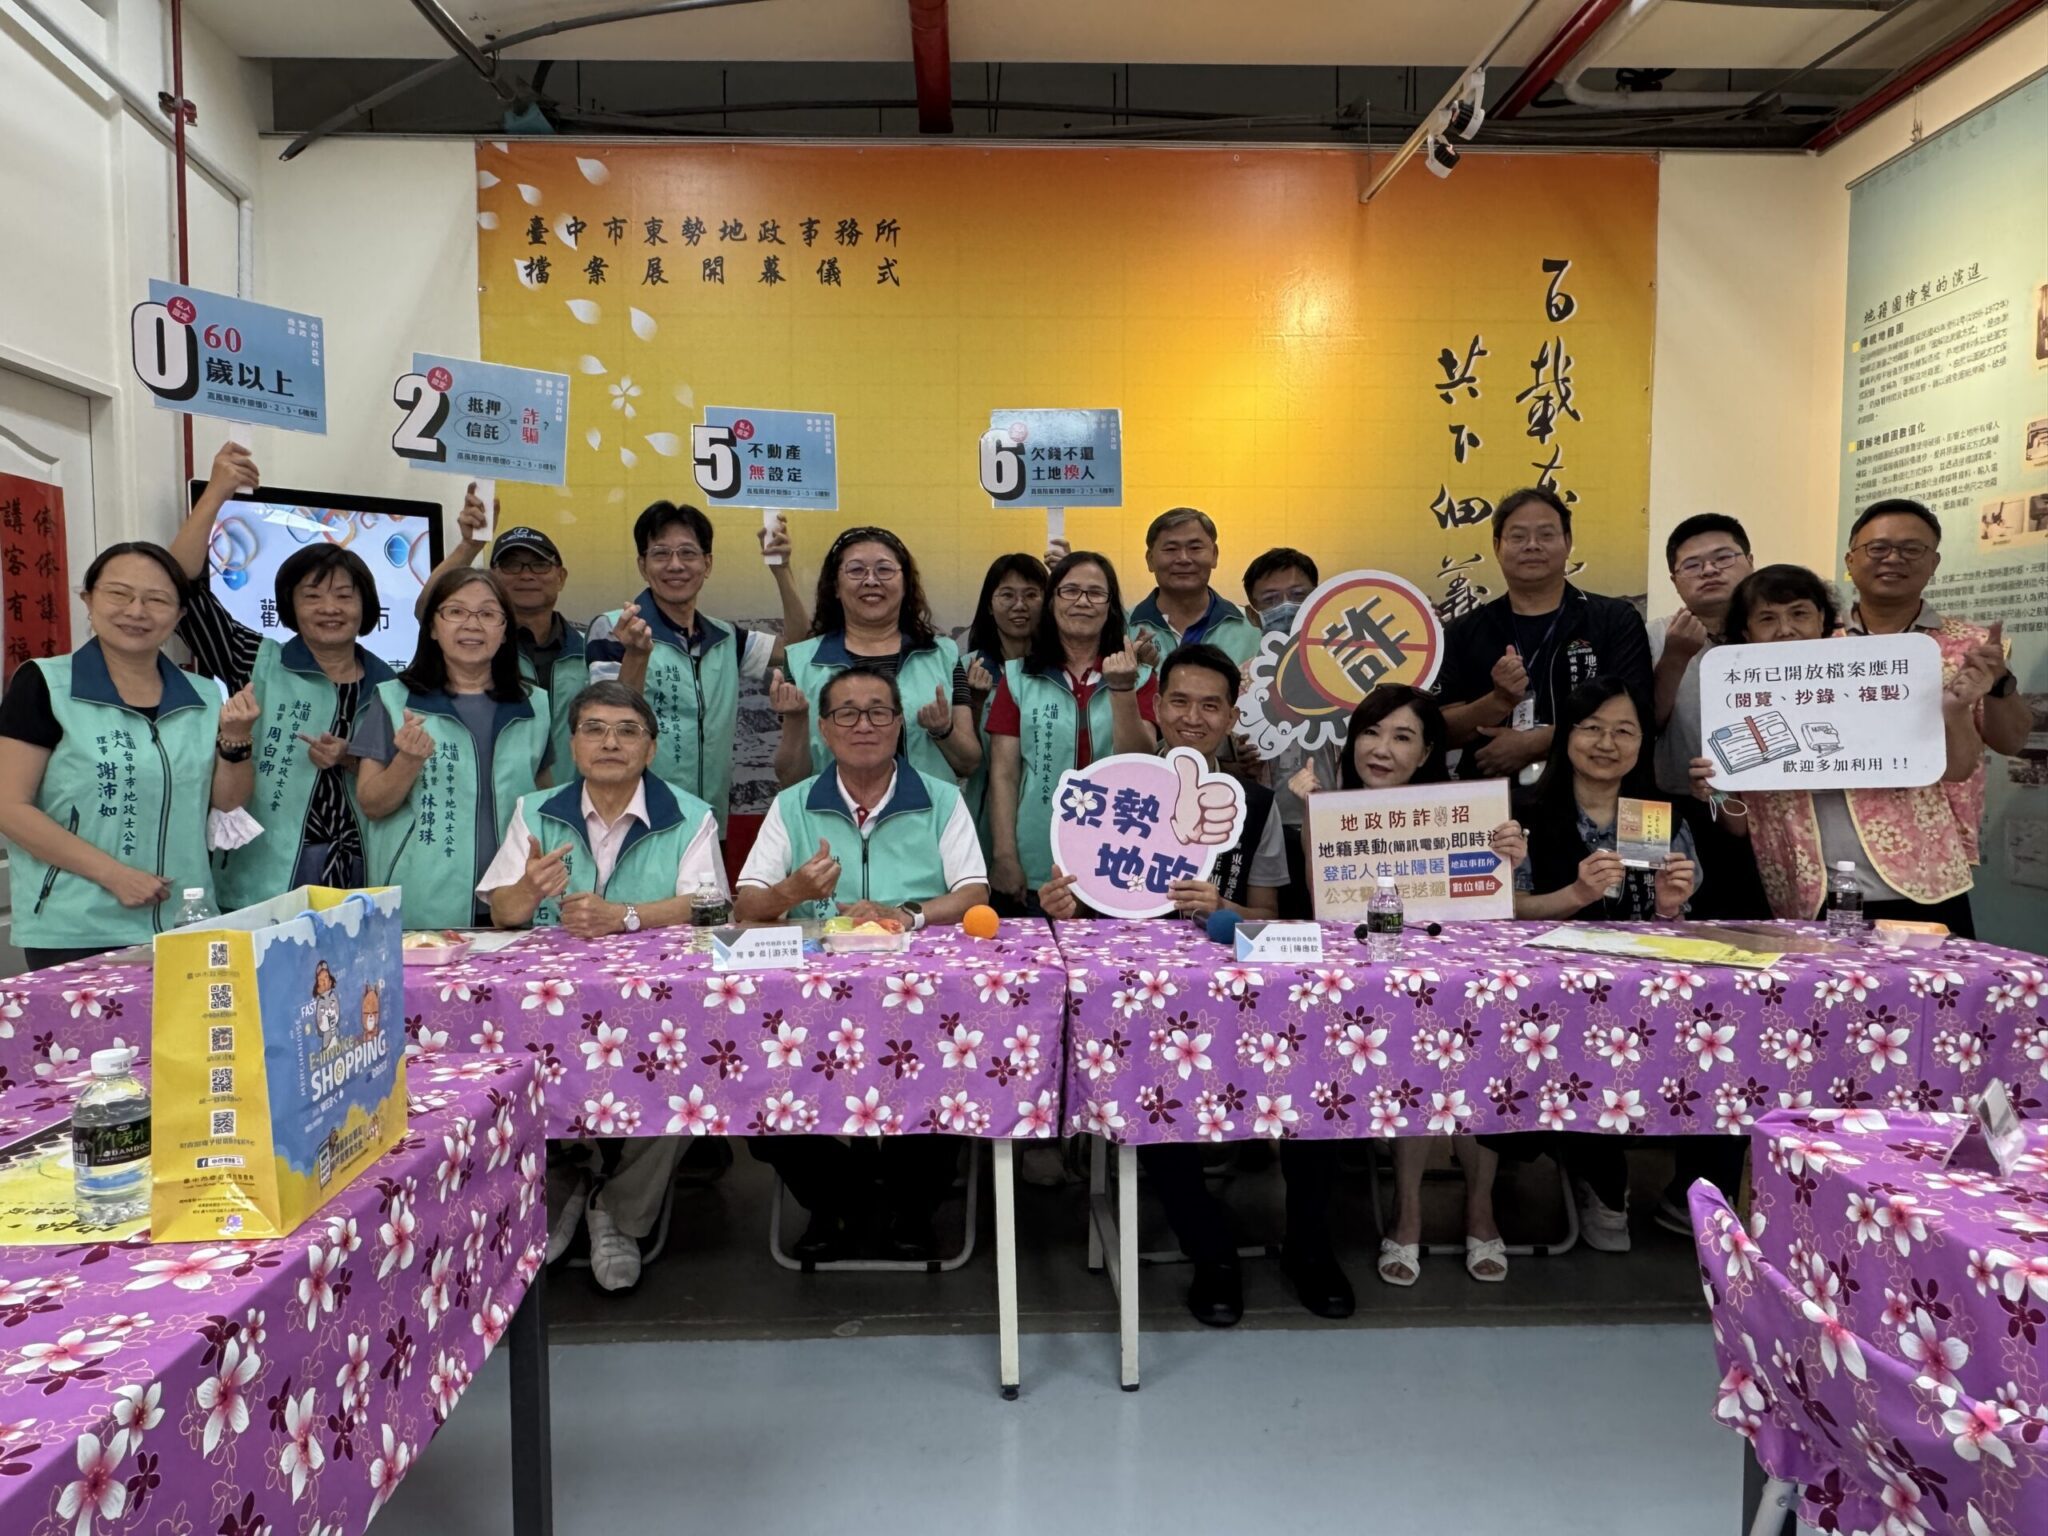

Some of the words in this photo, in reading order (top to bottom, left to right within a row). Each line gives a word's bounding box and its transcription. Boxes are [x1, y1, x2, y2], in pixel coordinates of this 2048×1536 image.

[526, 216, 901, 248] 臺中市東勢地政事務所
[524, 255, 901, 287] 檔案展開幕儀式
[131, 301, 200, 401] 0
[204, 324, 242, 353] 60
[205, 356, 295, 398] 歲以上
[392, 373, 450, 462] 2
[467, 396, 502, 416] 抵押
[466, 421, 499, 440] 信託
[521, 407, 540, 445] 詐騙
[692, 425, 741, 499] 5
[748, 443, 801, 460] 不動產
[980, 428, 1026, 500] 6
[1031, 446, 1095, 461] 欠錢不還
[749, 464, 802, 482] 無設定
[1032, 464, 1095, 480] 土地換人
[1, 497, 31, 662] 講客有福
[1723, 659, 1909, 685] 本所已開放檔案應用
[96, 762, 118, 817] 謝沛如
[122, 751, 138, 856] 台中市地政士公會
[419, 793, 438, 846] 林錦珠
[1341, 808, 1431, 832] 地政防詐
[1452, 805, 1470, 824] 招
[1323, 857, 1446, 882] 登記人住址隱匿
[1451, 858, 1496, 869] 地政事務所
[1452, 880, 1496, 893] 數位櫃台
[311, 1029, 387, 1102] SHOPPING
